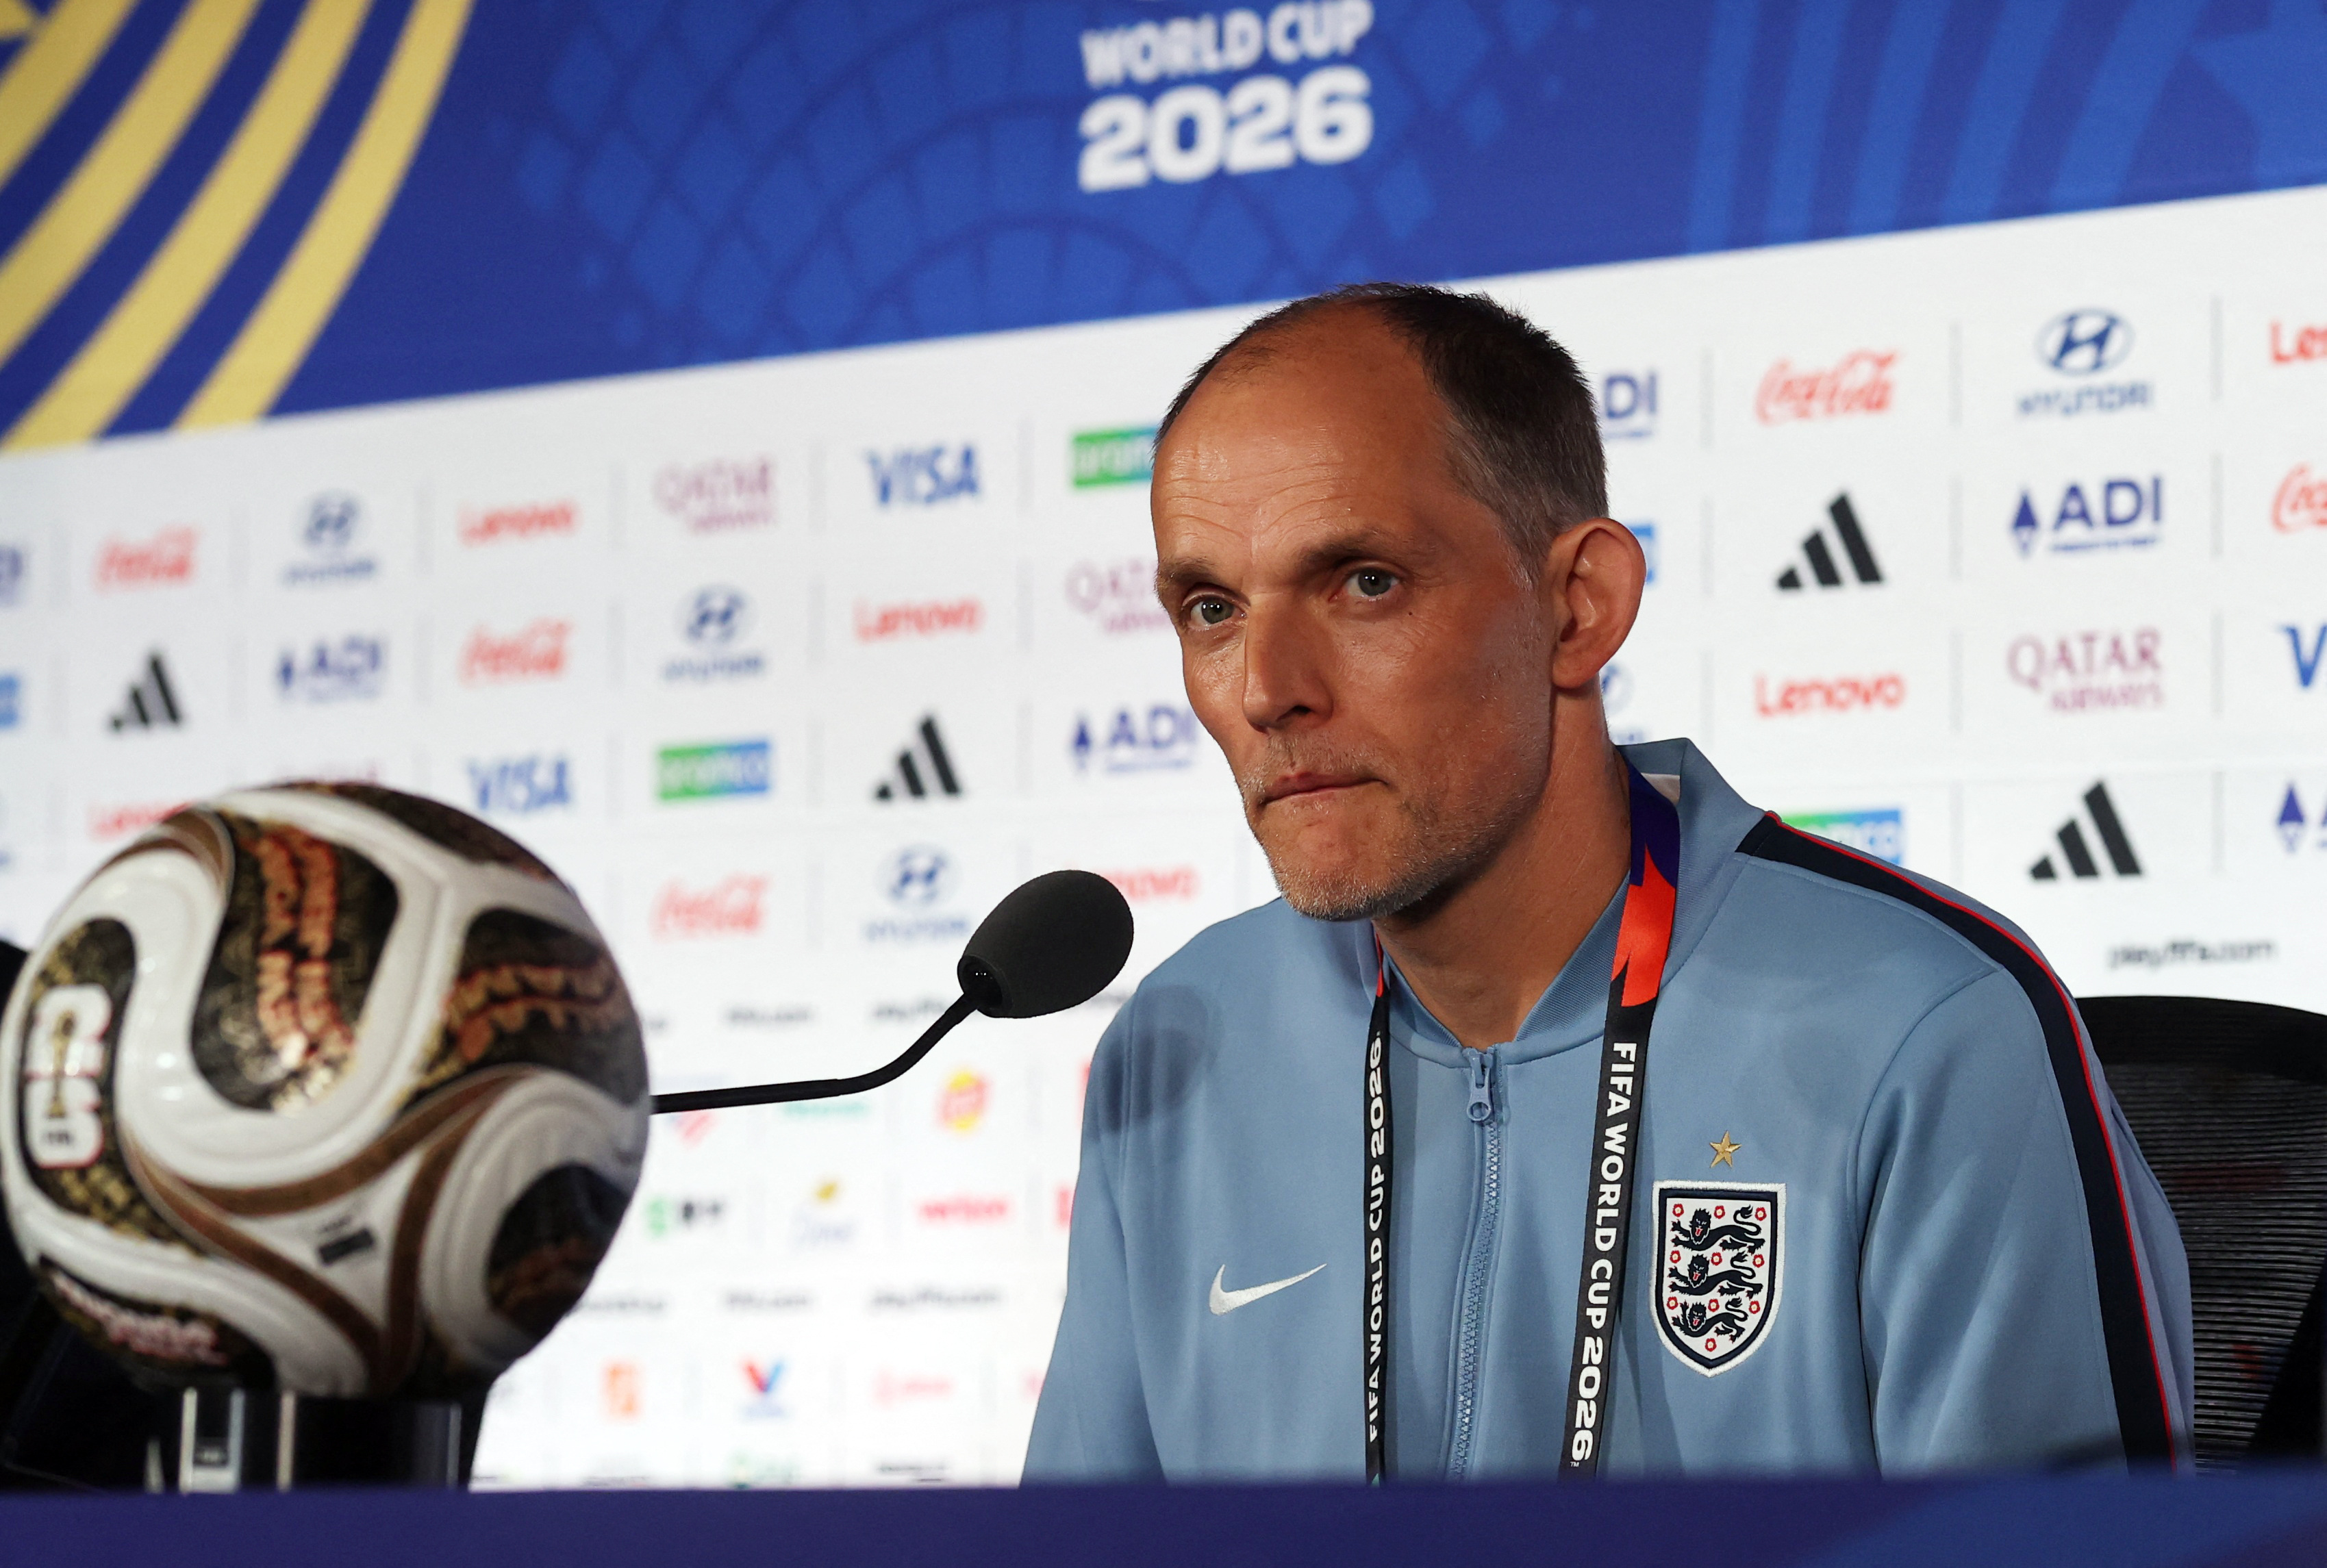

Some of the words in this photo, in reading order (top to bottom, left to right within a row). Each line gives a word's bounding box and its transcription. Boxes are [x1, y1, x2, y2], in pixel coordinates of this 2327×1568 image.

[1080, 10, 1263, 88] WORLD
[1267, 0, 1374, 63] CUP
[1078, 66, 1373, 192] 2026
[1602, 370, 1659, 419] DI
[1755, 350, 1898, 425] Coca-Cola
[865, 443, 982, 509] VISA
[2052, 476, 2163, 531] ADI
[854, 597, 983, 644] Lenovo
[1066, 559, 1159, 616] QAT
[2007, 627, 2162, 690] QATAR
[1107, 703, 1200, 750] ADI
[1754, 673, 1907, 719] Lenovo
[468, 750, 571, 811] VISA
[1369, 1037, 1385, 1159] 2026
[1607, 1042, 1637, 1117] FIFA
[1369, 1164, 1385, 1232] CUP
[1594, 1122, 1628, 1252] WORLD
[1370, 1237, 1383, 1365] WORLD
[1585, 1259, 1613, 1330] CUP
[1368, 1365, 1381, 1443] FIFA
[1571, 1336, 1604, 1461] 2026
